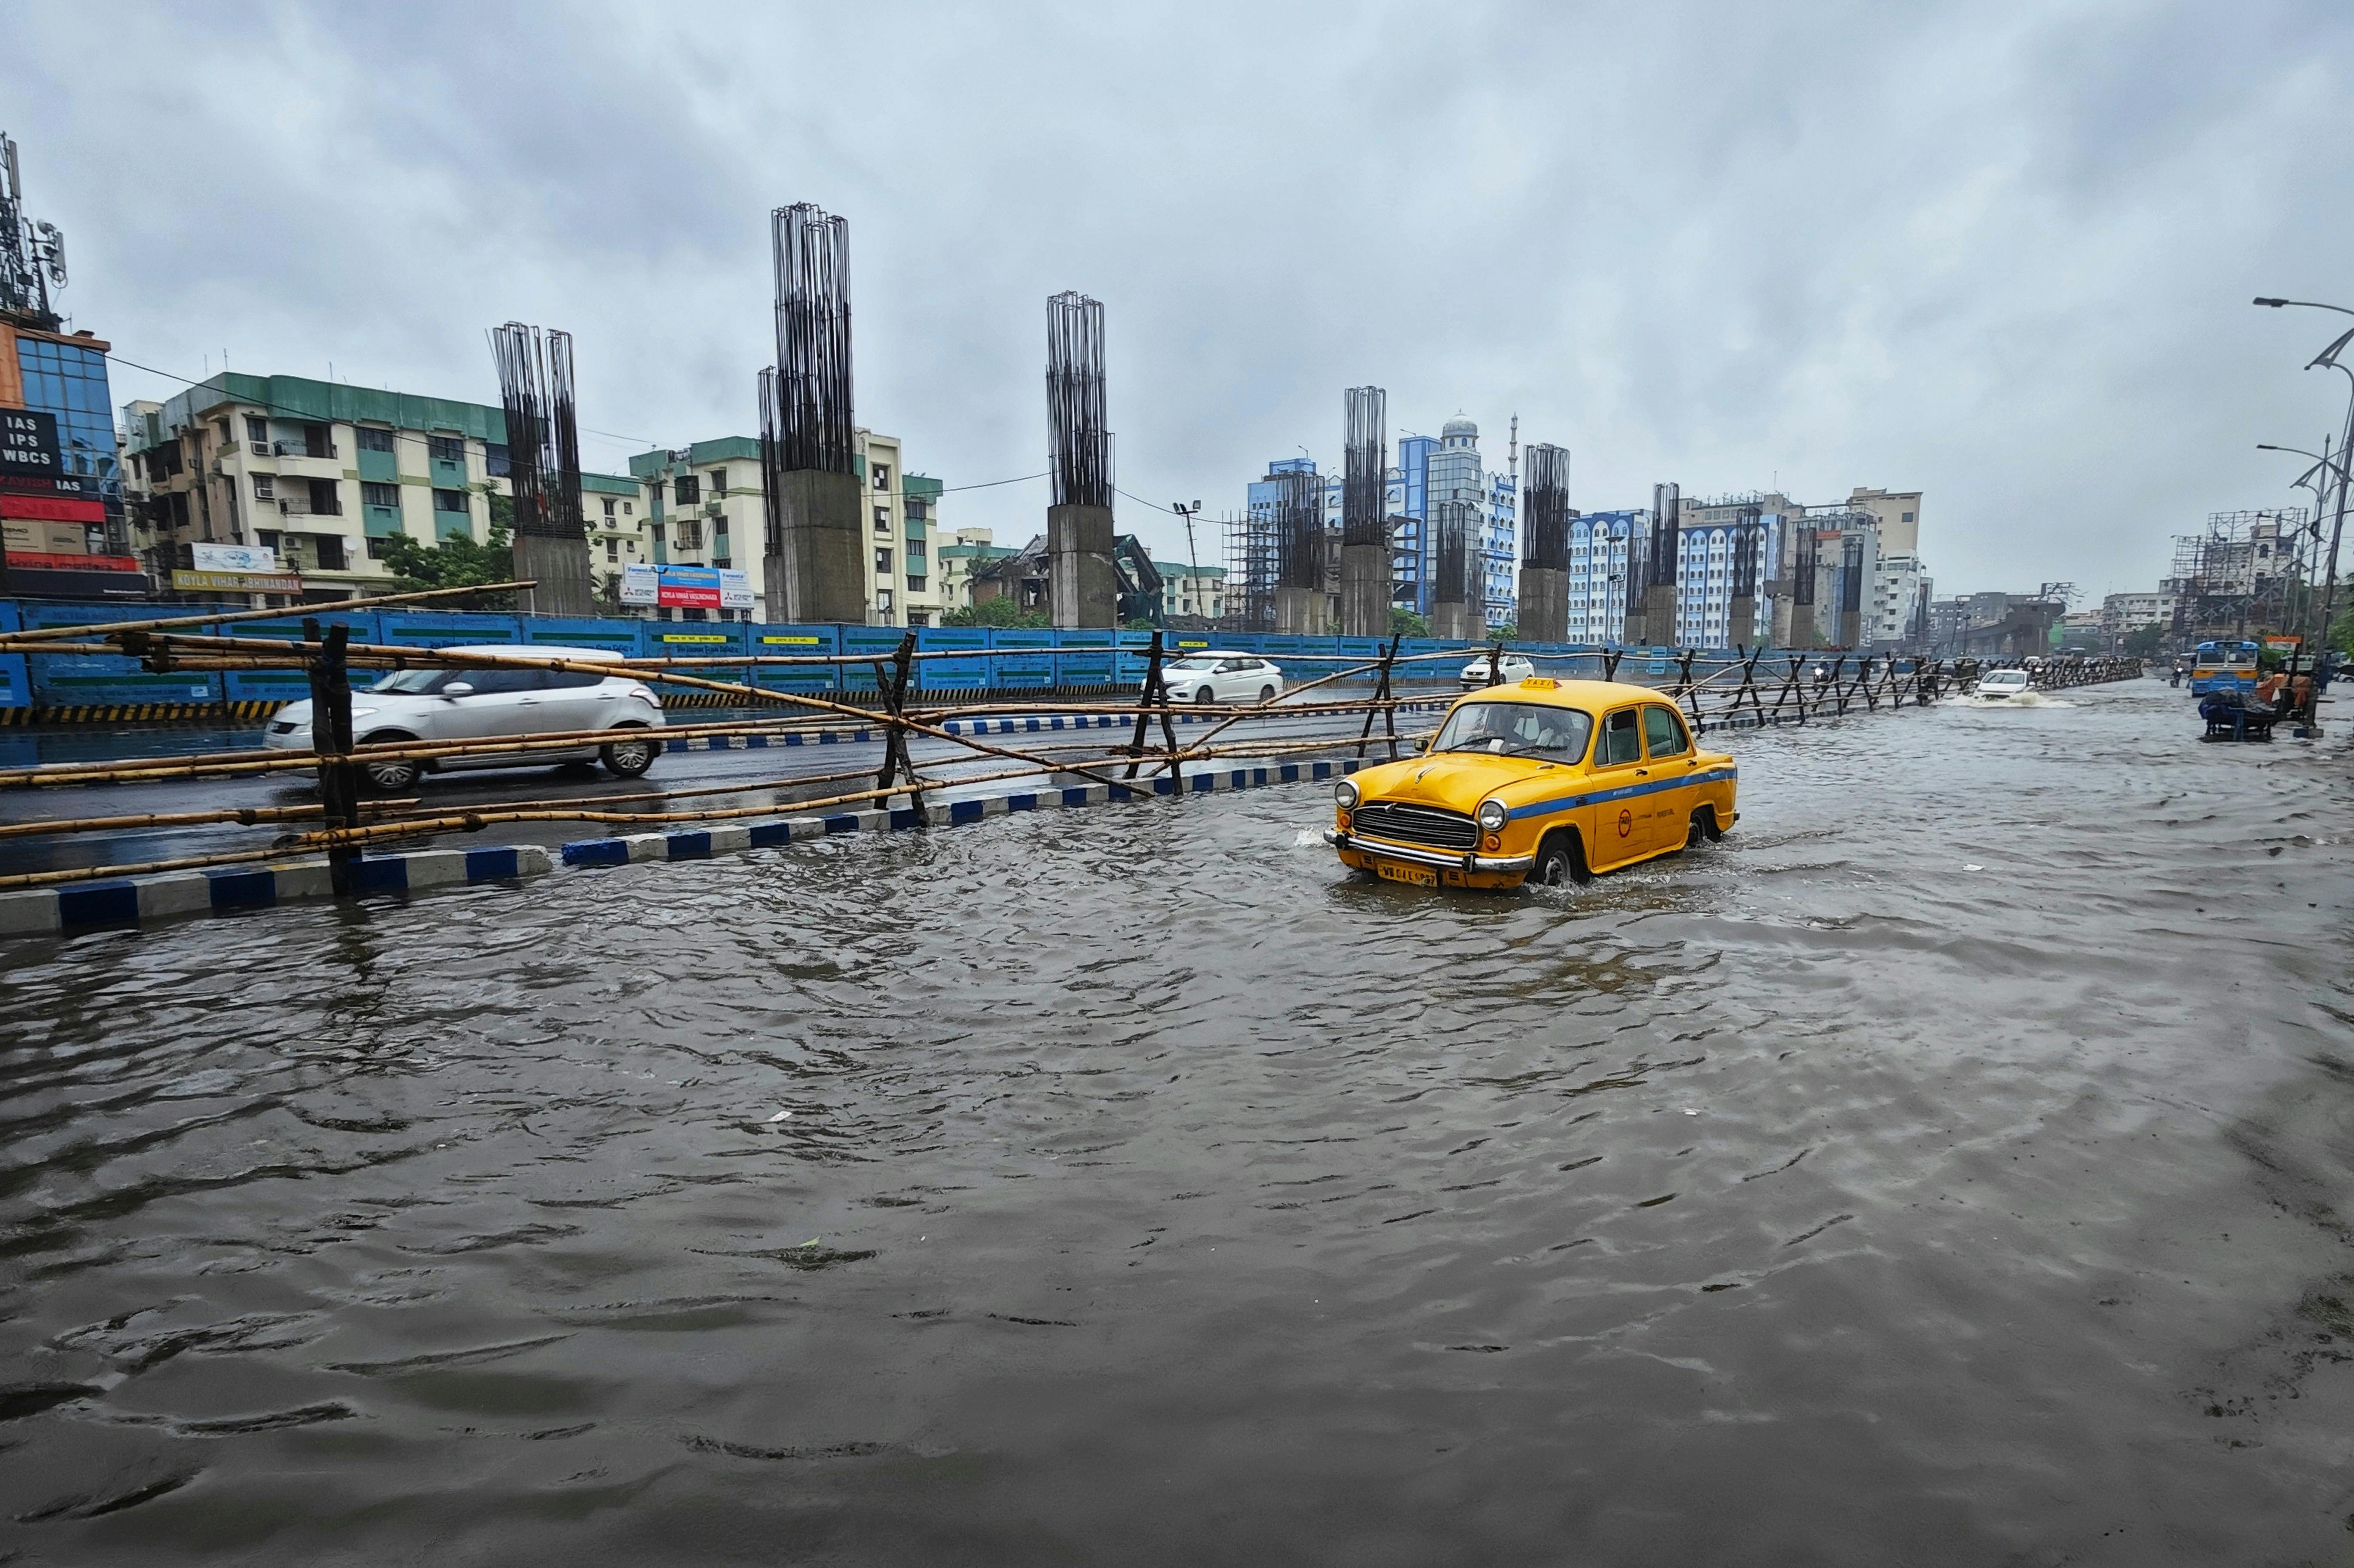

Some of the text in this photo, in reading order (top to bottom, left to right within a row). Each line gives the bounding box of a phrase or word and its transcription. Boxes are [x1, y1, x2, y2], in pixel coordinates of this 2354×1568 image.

[6, 416, 37, 431] IAS
[9, 433, 38, 447] IPS
[2, 449, 51, 465] WBCS
[56, 480, 81, 491] IAS
[177, 573, 299, 591] KOYLA VIHAR ABHINANDAN
